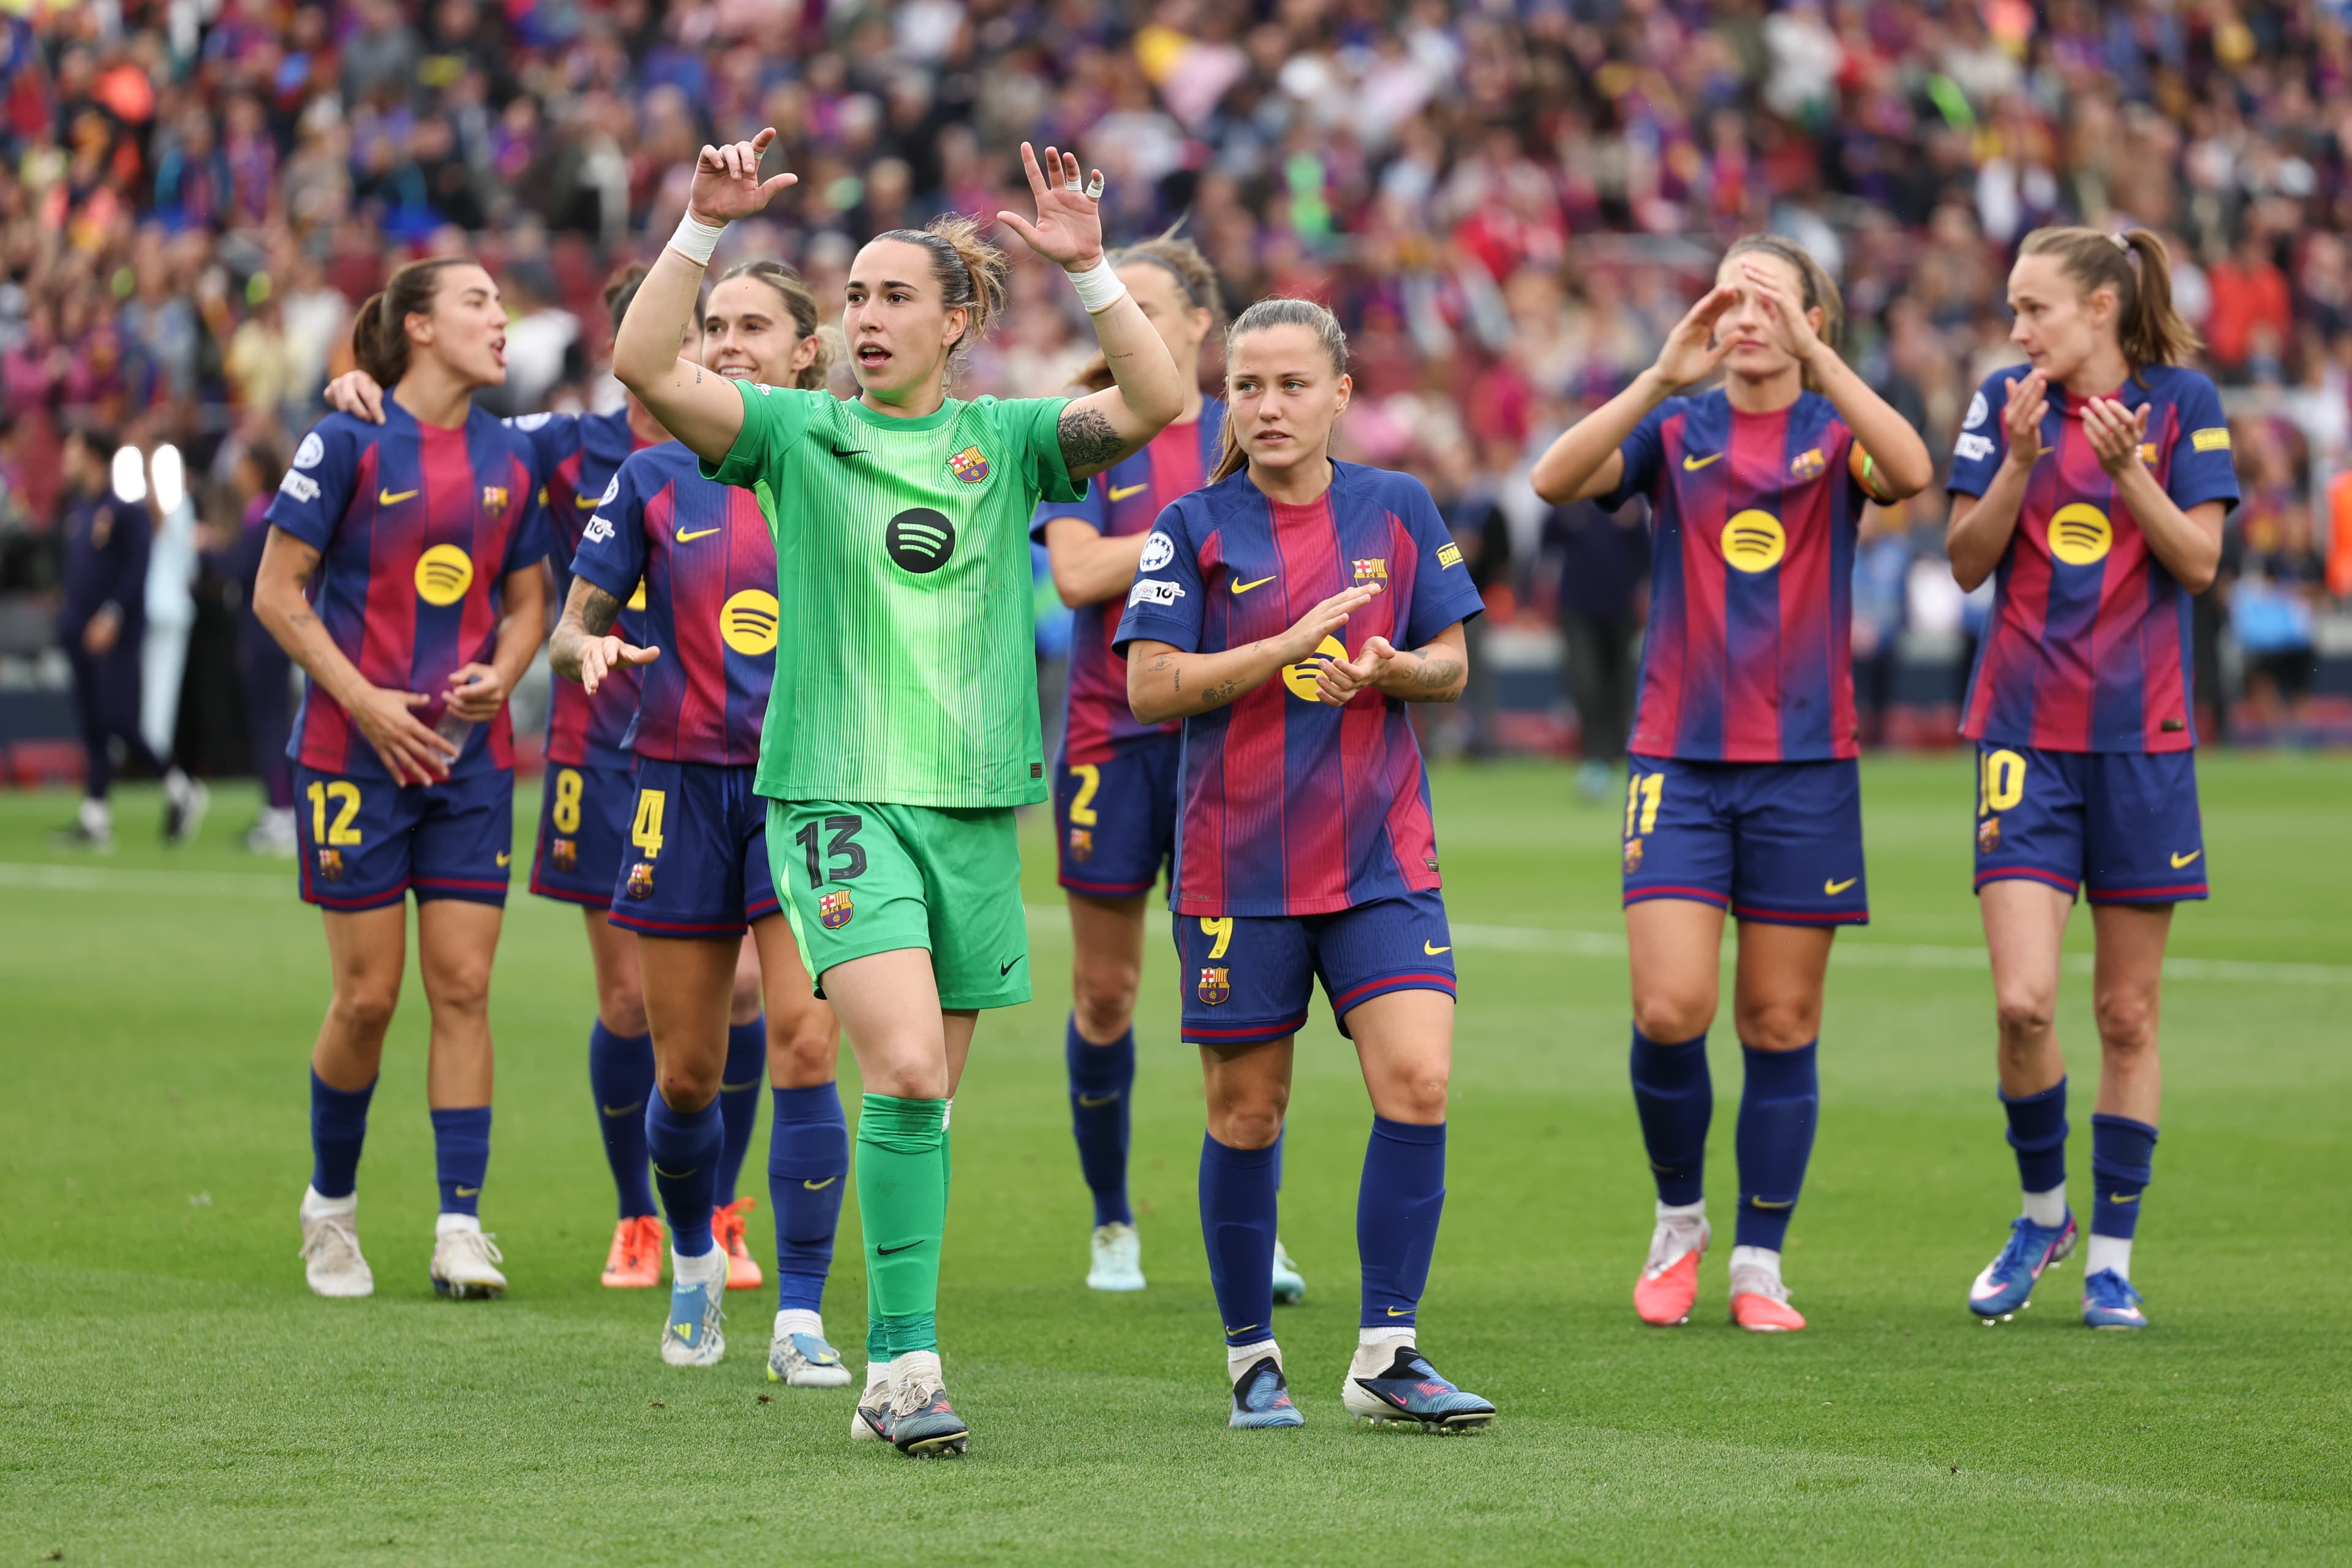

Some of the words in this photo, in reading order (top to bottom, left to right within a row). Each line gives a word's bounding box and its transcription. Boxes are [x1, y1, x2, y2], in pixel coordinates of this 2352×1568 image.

[1155, 586, 1173, 598] 10
[307, 780, 361, 845] 12
[553, 768, 584, 834] 8
[1069, 763, 1101, 826] 2
[1625, 773, 1665, 838] 11
[1979, 748, 2027, 817] 10
[632, 788, 666, 859] 4
[796, 815, 867, 890] 13
[1200, 917, 1234, 959] 9
